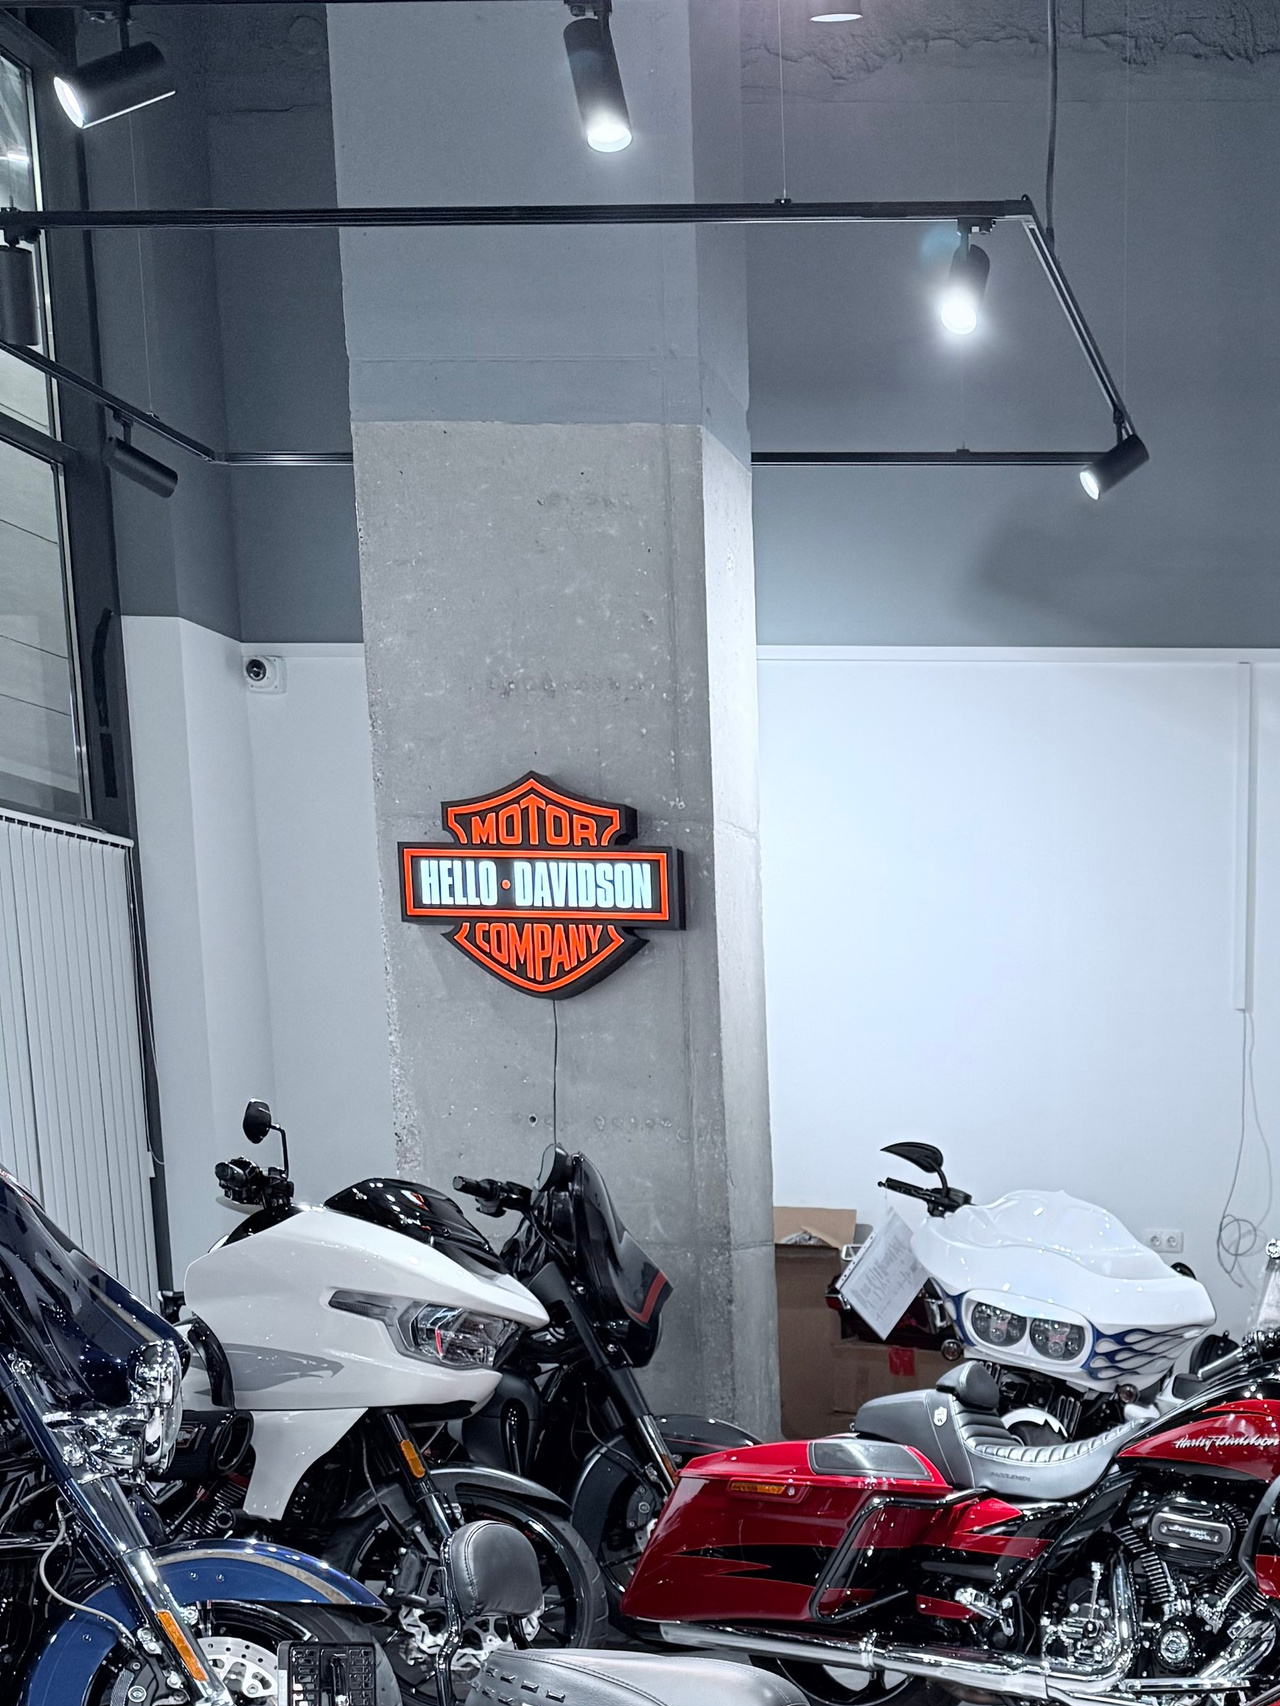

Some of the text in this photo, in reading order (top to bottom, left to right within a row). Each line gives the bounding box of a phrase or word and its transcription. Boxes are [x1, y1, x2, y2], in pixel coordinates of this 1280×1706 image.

[471, 793, 598, 846] MOTOR
[420, 859, 652, 909] HELLO DAVIDSON
[475, 922, 603, 981] COMPANY
